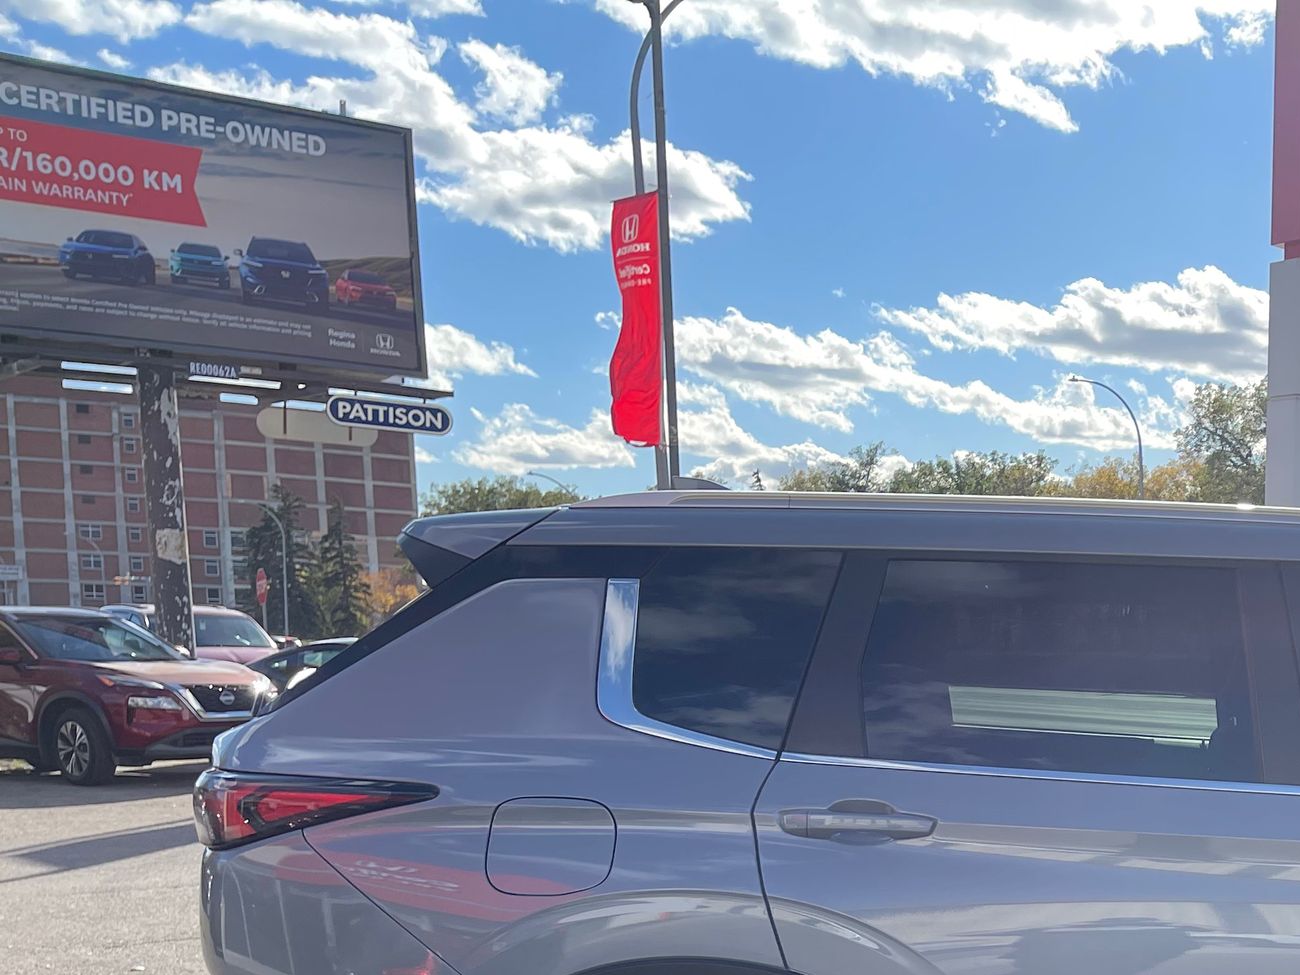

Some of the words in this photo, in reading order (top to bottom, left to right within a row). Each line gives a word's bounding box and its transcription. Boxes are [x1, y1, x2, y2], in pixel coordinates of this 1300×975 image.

[0, 81, 155, 128] CERTIFIED
[160, 109, 327, 157] PRE-OWNED
[7, 127, 28, 142] TO
[143, 168, 183, 194] KM
[337, 400, 443, 430] PATTISON
